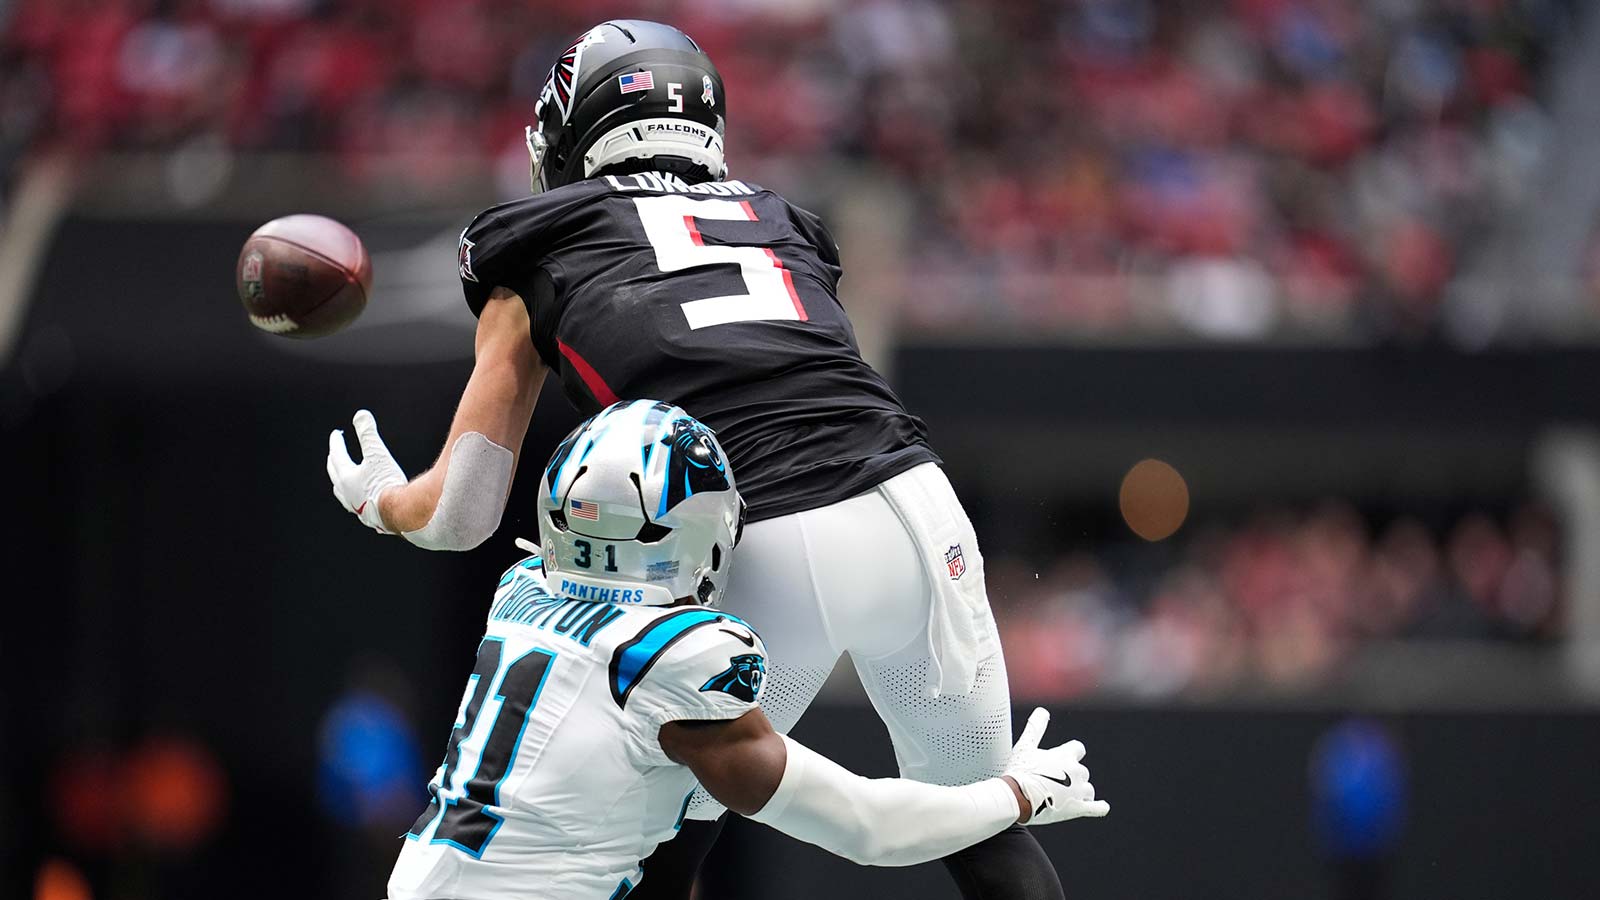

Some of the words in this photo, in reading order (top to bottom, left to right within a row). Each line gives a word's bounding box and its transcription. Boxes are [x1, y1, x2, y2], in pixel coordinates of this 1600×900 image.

[668, 83, 684, 112] 5
[647, 124, 706, 138] FALCONS
[633, 195, 809, 330] 5
[574, 539, 618, 573] 31
[948, 558, 963, 577] NFL
[561, 580, 644, 603] PANTHERS
